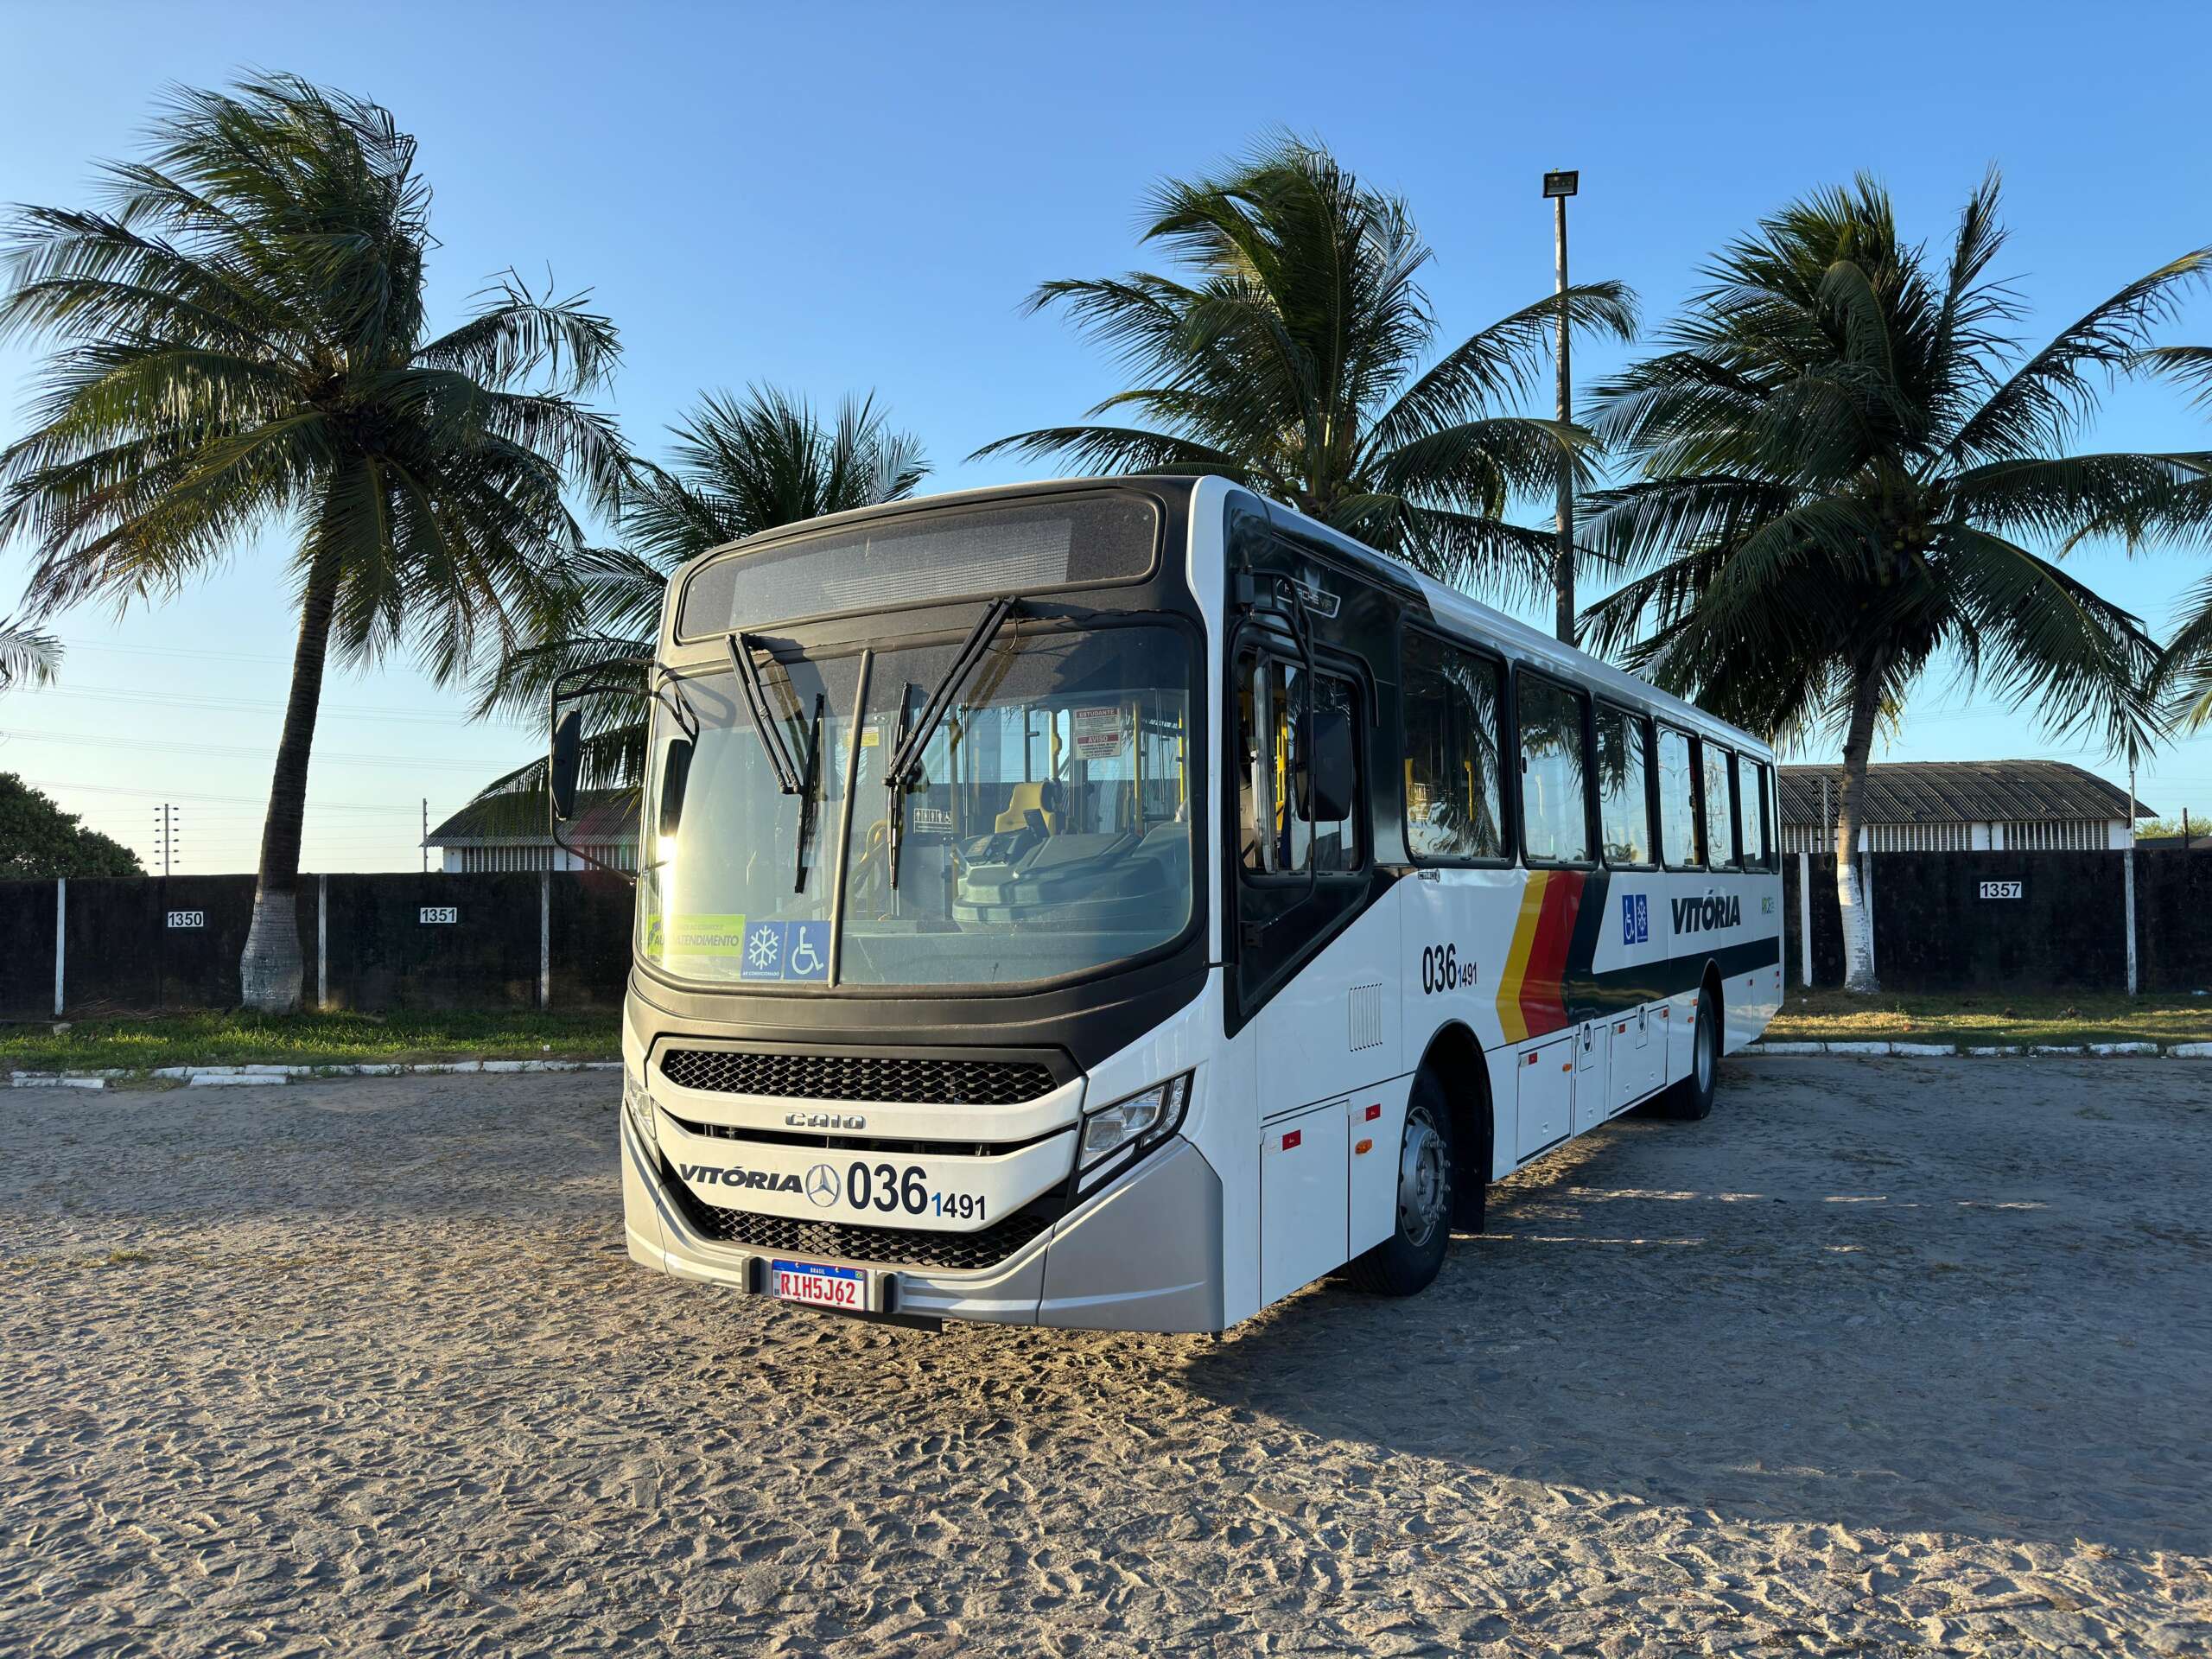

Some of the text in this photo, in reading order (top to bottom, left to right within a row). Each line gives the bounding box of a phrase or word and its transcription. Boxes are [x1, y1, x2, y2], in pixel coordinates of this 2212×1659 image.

[1981, 883, 2020, 898] 1357
[168, 912, 202, 926] 1350
[423, 908, 455, 922] 1351
[1671, 889, 1741, 935] VITÓRIA
[1422, 943, 1477, 995] 036 1491
[785, 1112, 867, 1129] CAIO
[679, 1163, 804, 1193] VITÓRIA
[847, 1161, 986, 1221] 036 1491
[780, 1273, 855, 1304] RIH5J62
